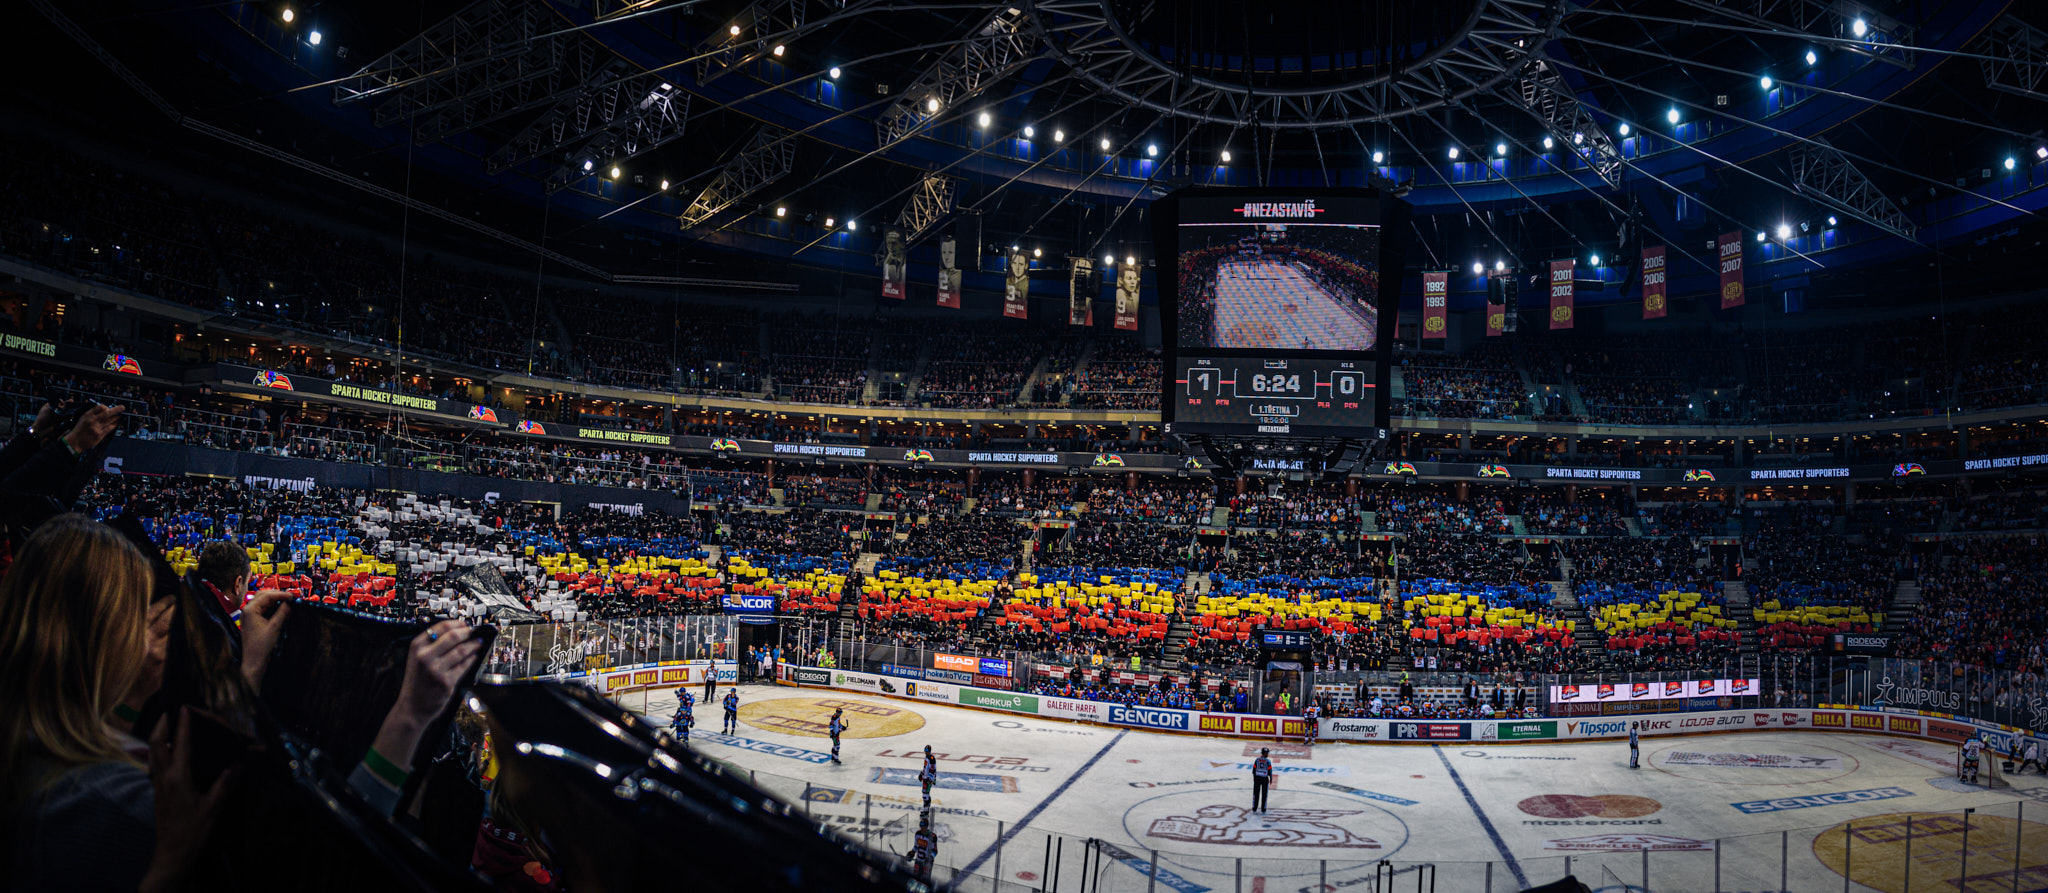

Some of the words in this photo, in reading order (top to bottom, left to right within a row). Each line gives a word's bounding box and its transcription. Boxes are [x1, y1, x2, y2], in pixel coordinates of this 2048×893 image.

[1721, 241, 1742, 256] 2006
[1643, 255, 1664, 269] 2005
[1721, 258, 1741, 273] 2007
[1552, 269, 1572, 282] 2001
[1643, 272, 1665, 286] 2006
[1005, 285, 1016, 302] 3
[1425, 281, 1445, 293] 1992
[1552, 285, 1573, 298] 2002
[1425, 296, 1445, 308] 1993
[5, 333, 56, 358] SUPPORTERS
[1197, 372, 1210, 391] 1
[1252, 373, 1301, 393] 6:24
[1339, 375, 1356, 395] 0
[331, 383, 361, 399] SPARTA
[362, 387, 391, 405] HOCKEY
[392, 393, 438, 412] SUPPORTERS
[579, 428, 604, 441] SPARTA
[604, 430, 630, 443] HOCKEY
[630, 432, 671, 446] SUPPORTERS
[774, 443, 799, 455] SPARTA
[800, 444, 824, 456] HOCKEY
[825, 446, 866, 458] SUPPORTERS
[968, 451, 992, 462] SPARTA
[993, 452, 1017, 464] HOCKEY
[1018, 453, 1059, 465] SUPPORTERS
[1965, 459, 1992, 471] SPARTA
[1993, 456, 2021, 469] HOCKEY
[1546, 467, 1572, 478] SPARTA
[1573, 467, 1599, 479] HOCKEY
[1599, 468, 1641, 480] SUPPORTERS
[1750, 469, 1776, 480] SPARTA
[1778, 468, 1804, 480] HOCKEY
[1805, 467, 1850, 479] SUPPORTERS
[936, 655, 974, 666] HEAD
[981, 661, 1007, 669] HEAD
[608, 675, 630, 691] BILLA
[635, 672, 657, 686] BILLA
[663, 669, 688, 683] BILLA
[1896, 686, 1960, 710] IMPULS
[1047, 700, 1074, 712] GALERIE
[1075, 702, 1097, 714] HARFA
[1113, 707, 1183, 727] SENCOR
[1201, 716, 1233, 730] BILLA
[1813, 713, 1845, 727] BILLA
[1852, 715, 1883, 729] BILLA
[1242, 718, 1275, 732] BILLA
[1332, 721, 1376, 732] Prostamol
[1397, 724, 1427, 738] PRE
[1512, 724, 1541, 734] ETERNAL
[1580, 721, 1626, 736] Tipsport
[1651, 721, 1672, 730] KFC
[1891, 717, 1920, 733] BILLA
[694, 729, 829, 763] SENCOR
[1740, 787, 1905, 813] SENCOR
[1522, 817, 1663, 828] mastercard
